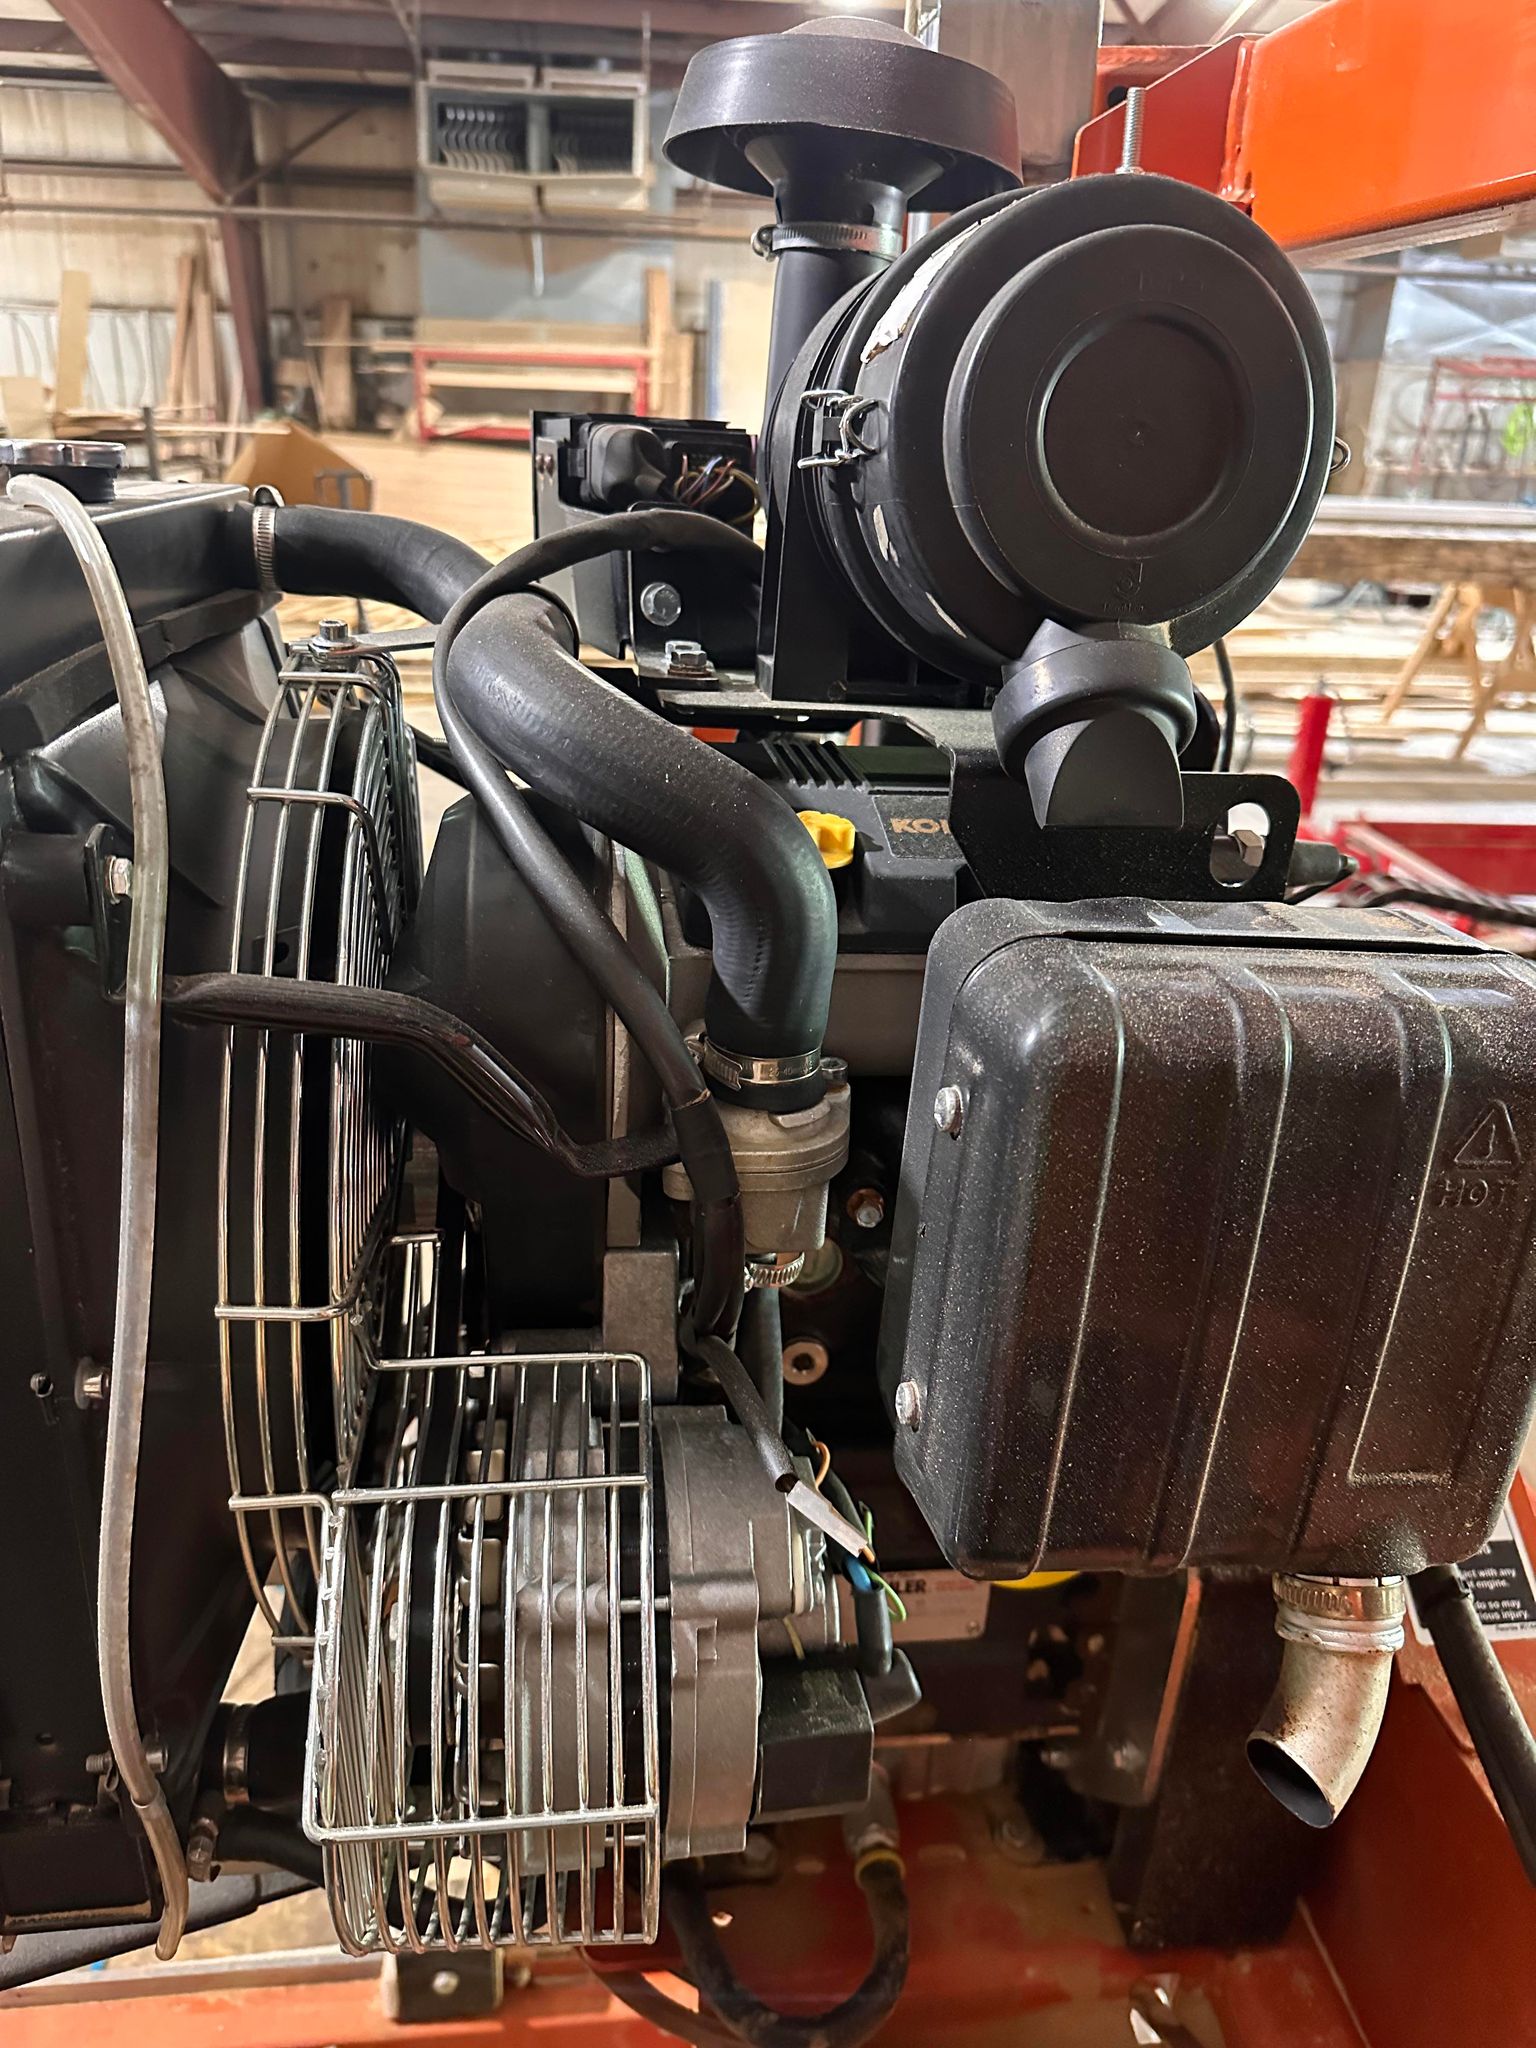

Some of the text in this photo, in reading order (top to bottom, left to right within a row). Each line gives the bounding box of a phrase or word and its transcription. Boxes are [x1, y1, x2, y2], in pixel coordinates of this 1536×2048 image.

[1437, 1178, 1520, 1208] HOT
[1478, 1568, 1498, 1578] with
[1499, 1568, 1516, 1578] any
[889, 1579, 926, 1594] LER
[1501, 1599, 1521, 1609] may
